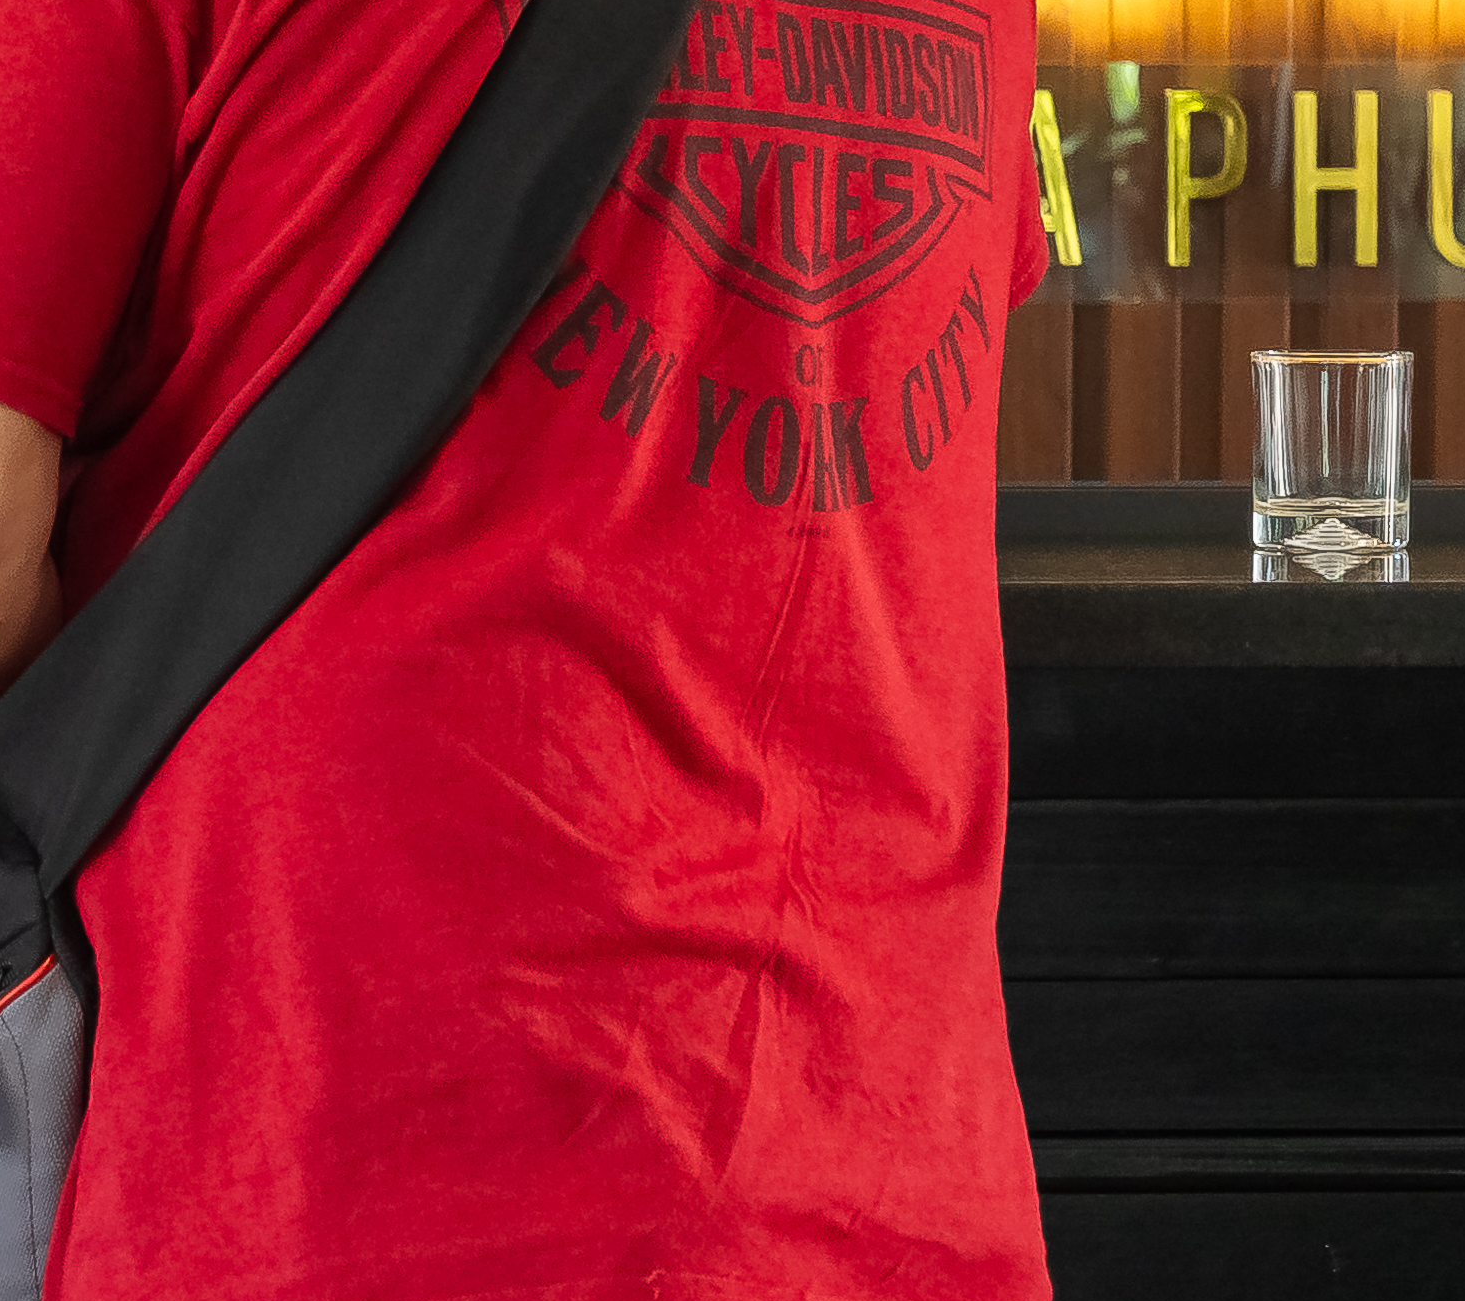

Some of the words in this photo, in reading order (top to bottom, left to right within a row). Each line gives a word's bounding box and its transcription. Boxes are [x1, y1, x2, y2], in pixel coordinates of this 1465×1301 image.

[684, 135, 914, 277] CYCLES
[532, 263, 676, 438] EW
[901, 263, 991, 472] CITY
